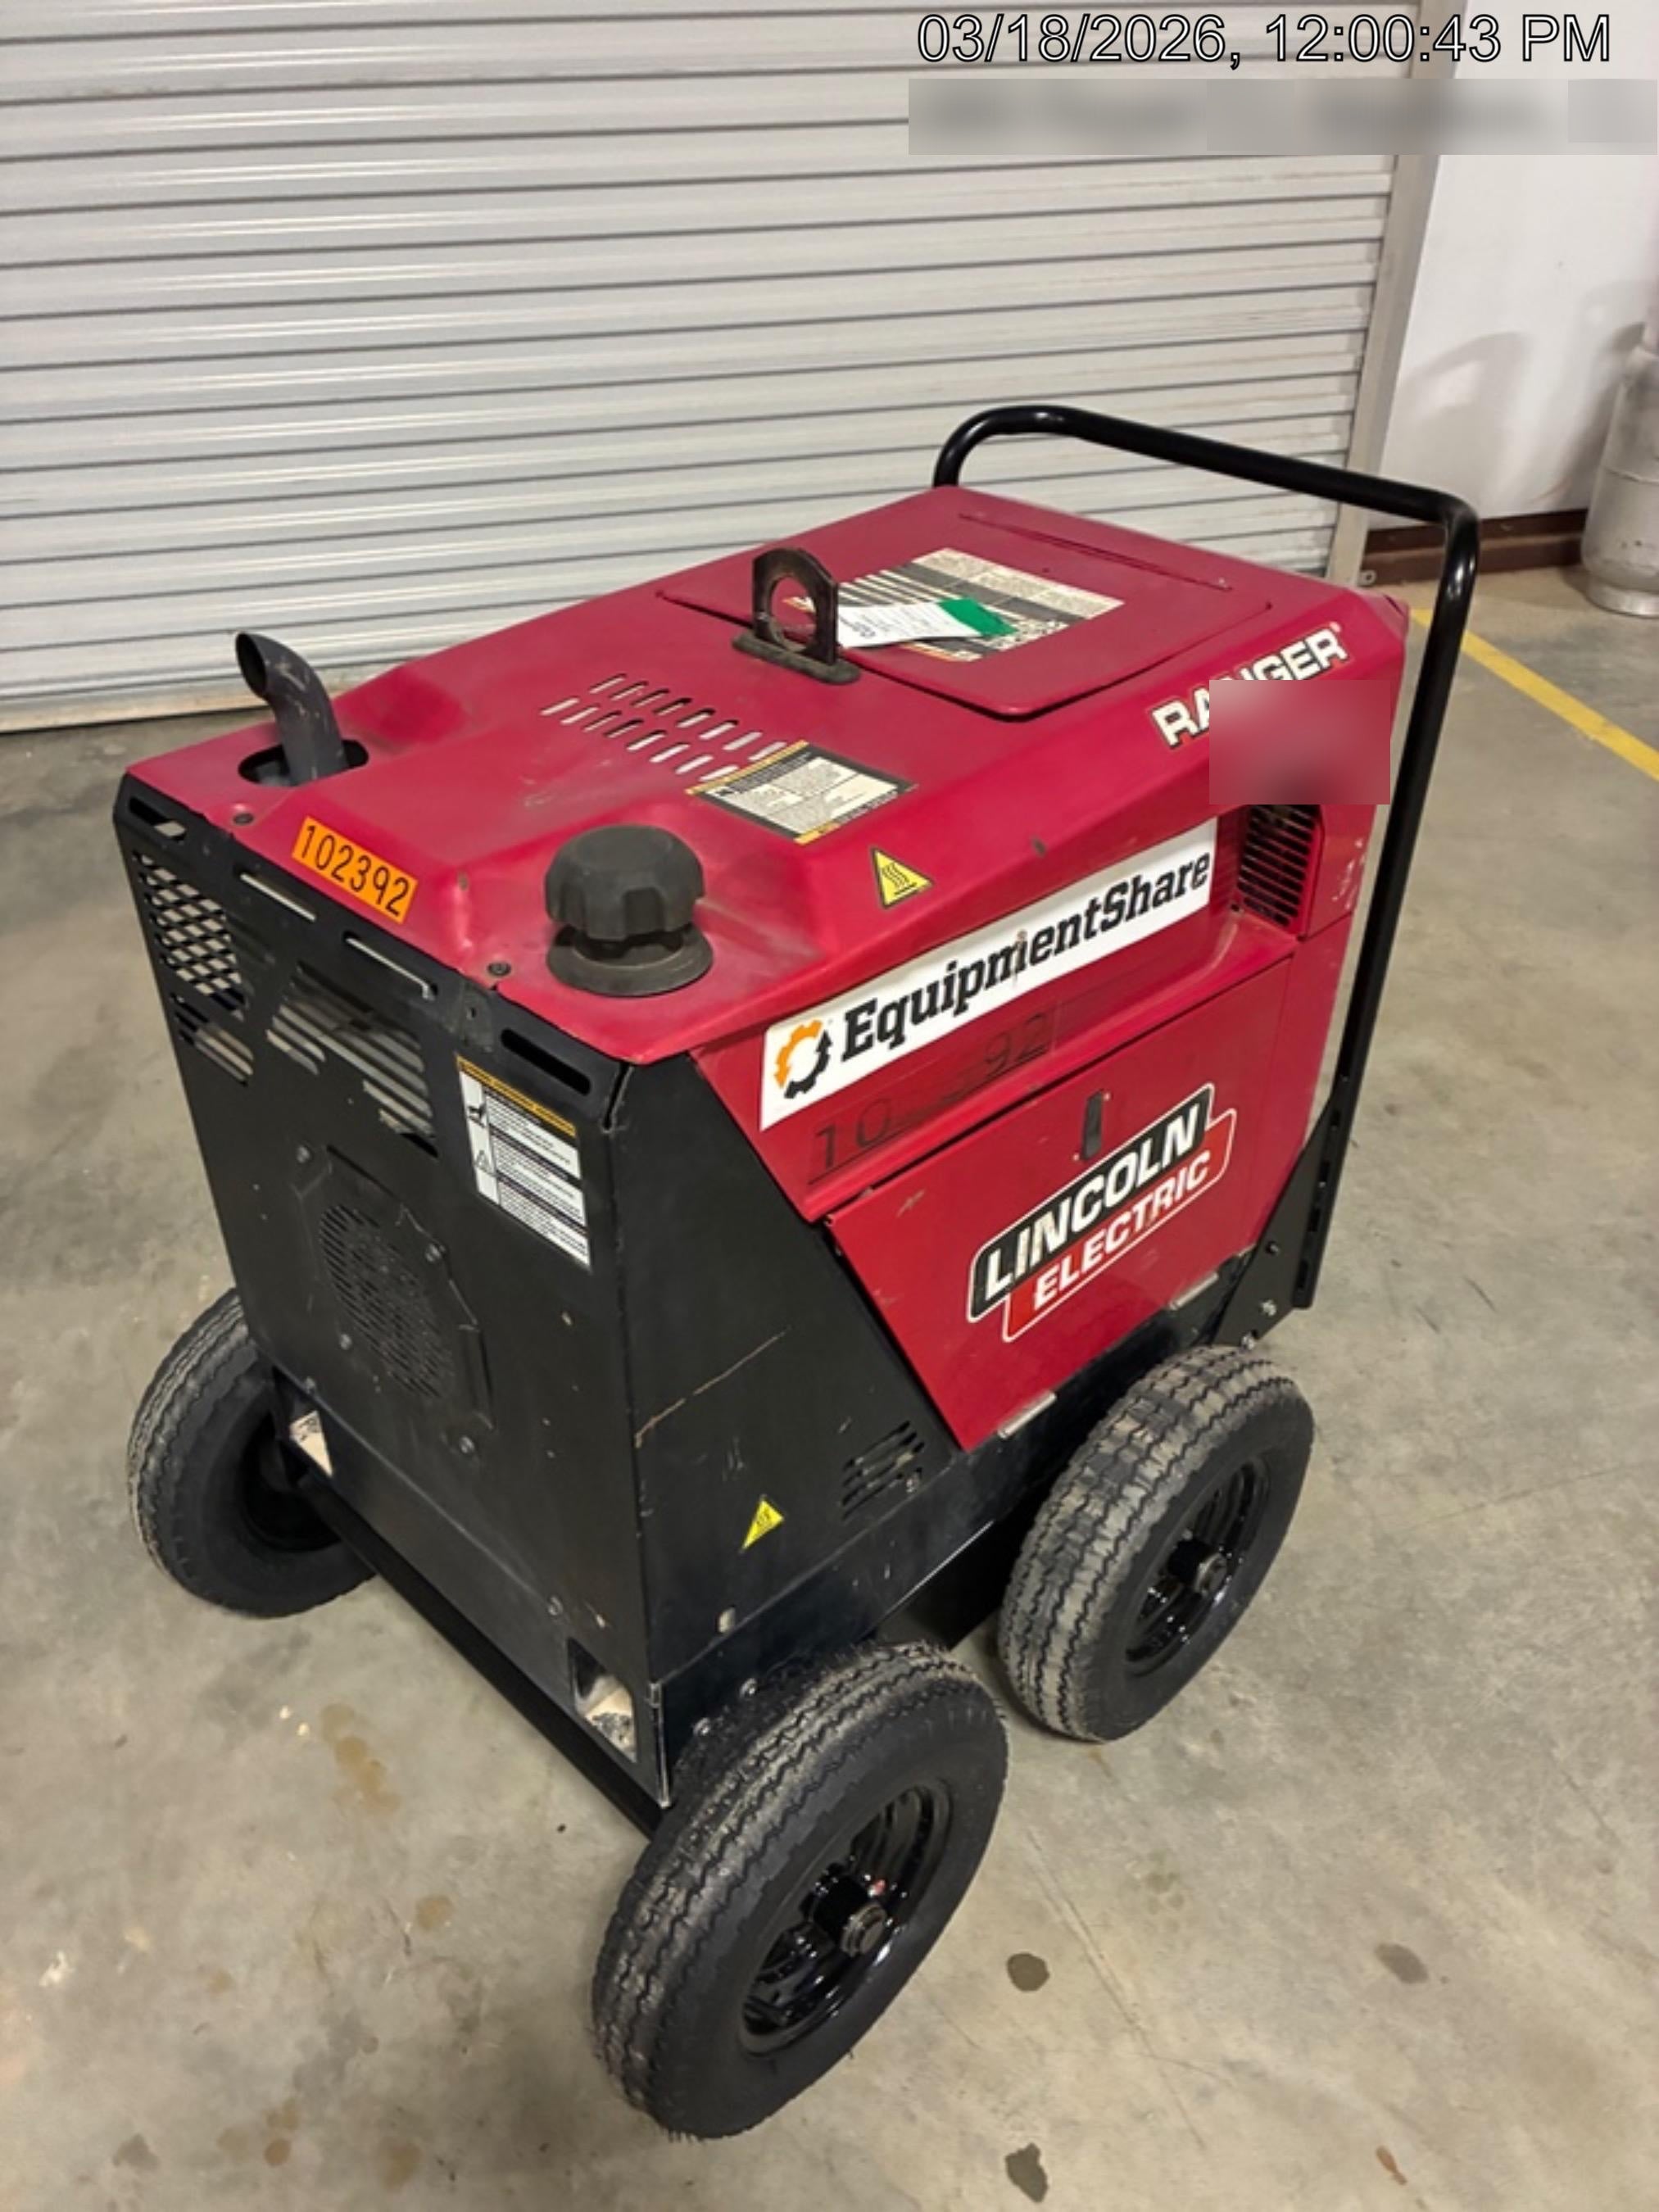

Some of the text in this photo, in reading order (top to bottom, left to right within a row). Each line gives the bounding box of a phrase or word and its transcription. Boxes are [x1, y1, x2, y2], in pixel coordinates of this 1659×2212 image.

[1151, 629, 1348, 748] RAGER
[301, 825, 410, 917] 102392
[841, 852, 1211, 1063] EquipmentShare
[985, 1103, 1199, 1301] LINCOLN
[1035, 1150, 1211, 1311] ELECTRIC
